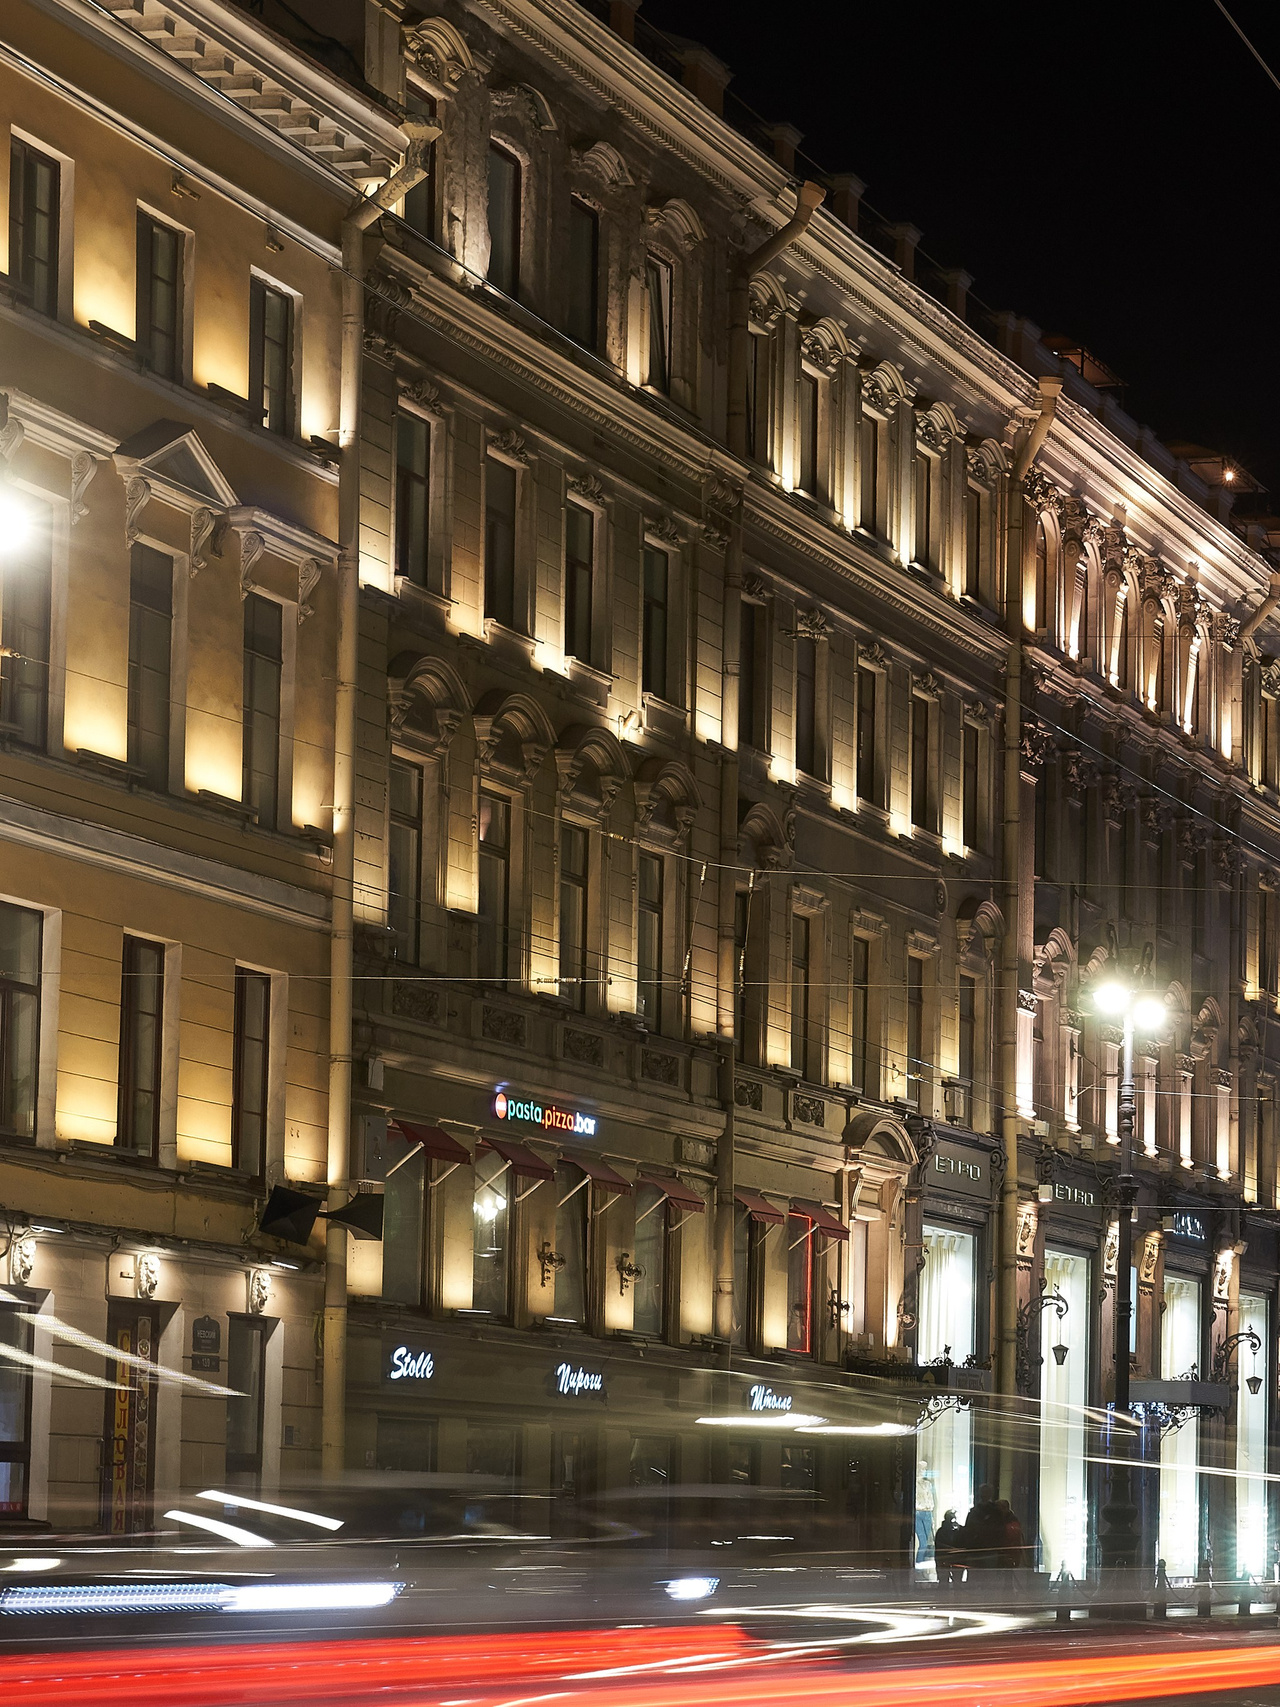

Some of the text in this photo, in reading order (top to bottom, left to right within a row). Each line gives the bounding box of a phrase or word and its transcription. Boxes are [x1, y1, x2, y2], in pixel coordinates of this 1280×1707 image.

[935, 1154, 981, 1182] ETRO
[1055, 1183, 1094, 1207] ETRO
[390, 1346, 434, 1380] Stolle
[557, 1362, 602, 1395] Пироги
